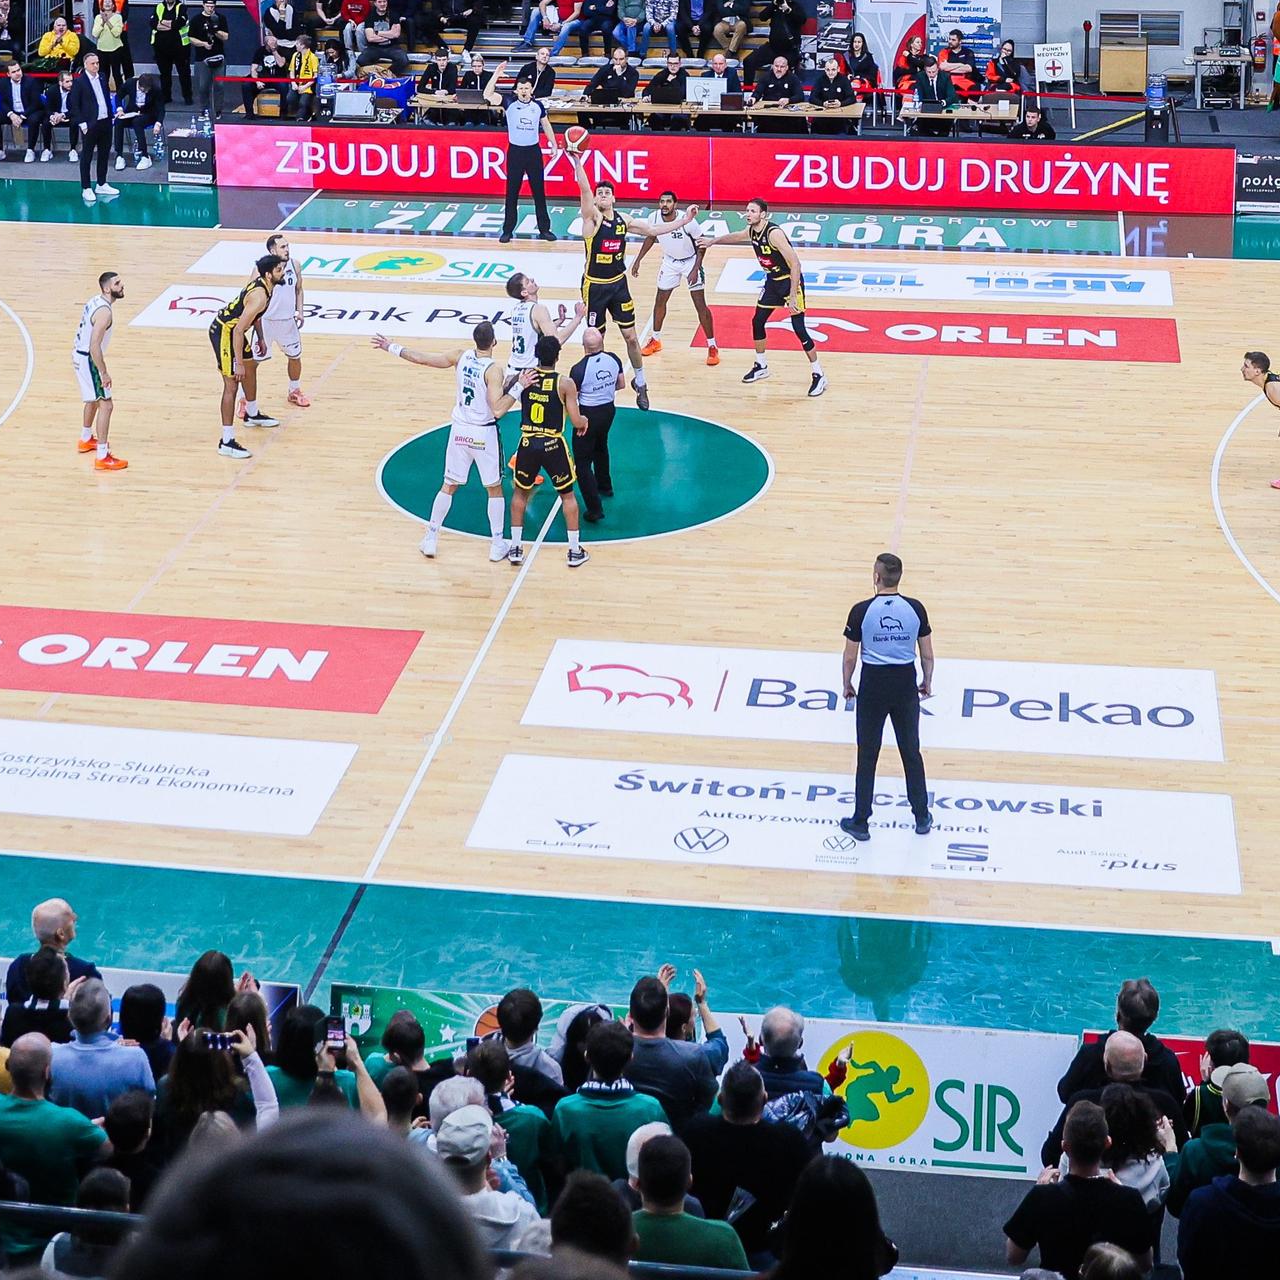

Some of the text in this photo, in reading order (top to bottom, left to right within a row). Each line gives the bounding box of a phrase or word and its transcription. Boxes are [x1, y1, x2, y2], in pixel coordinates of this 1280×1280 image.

[172, 147, 208, 162] posto
[274, 140, 438, 180] ZBUDUJ
[774, 153, 1171, 205] ZBUDUJ DRUŻYNĘ
[670, 231, 684, 240] 32
[786, 217, 1008, 249] GÓRA
[883, 322, 1118, 349] ORLEN
[530, 402, 545, 424] 0
[873, 633, 911, 642] Bank Pekao
[17, 632, 330, 682] ORLEN
[960, 686, 1197, 729] Pekao
[85, 770, 150, 786] Strefa
[155, 775, 296, 797] Ekonomiczna
[697, 808, 990, 835] Autoryzowany Marek
[525, 839, 612, 851] CUPRA
[930, 862, 1004, 873] SEAT
[888, 1152, 928, 1166] GÓRA
